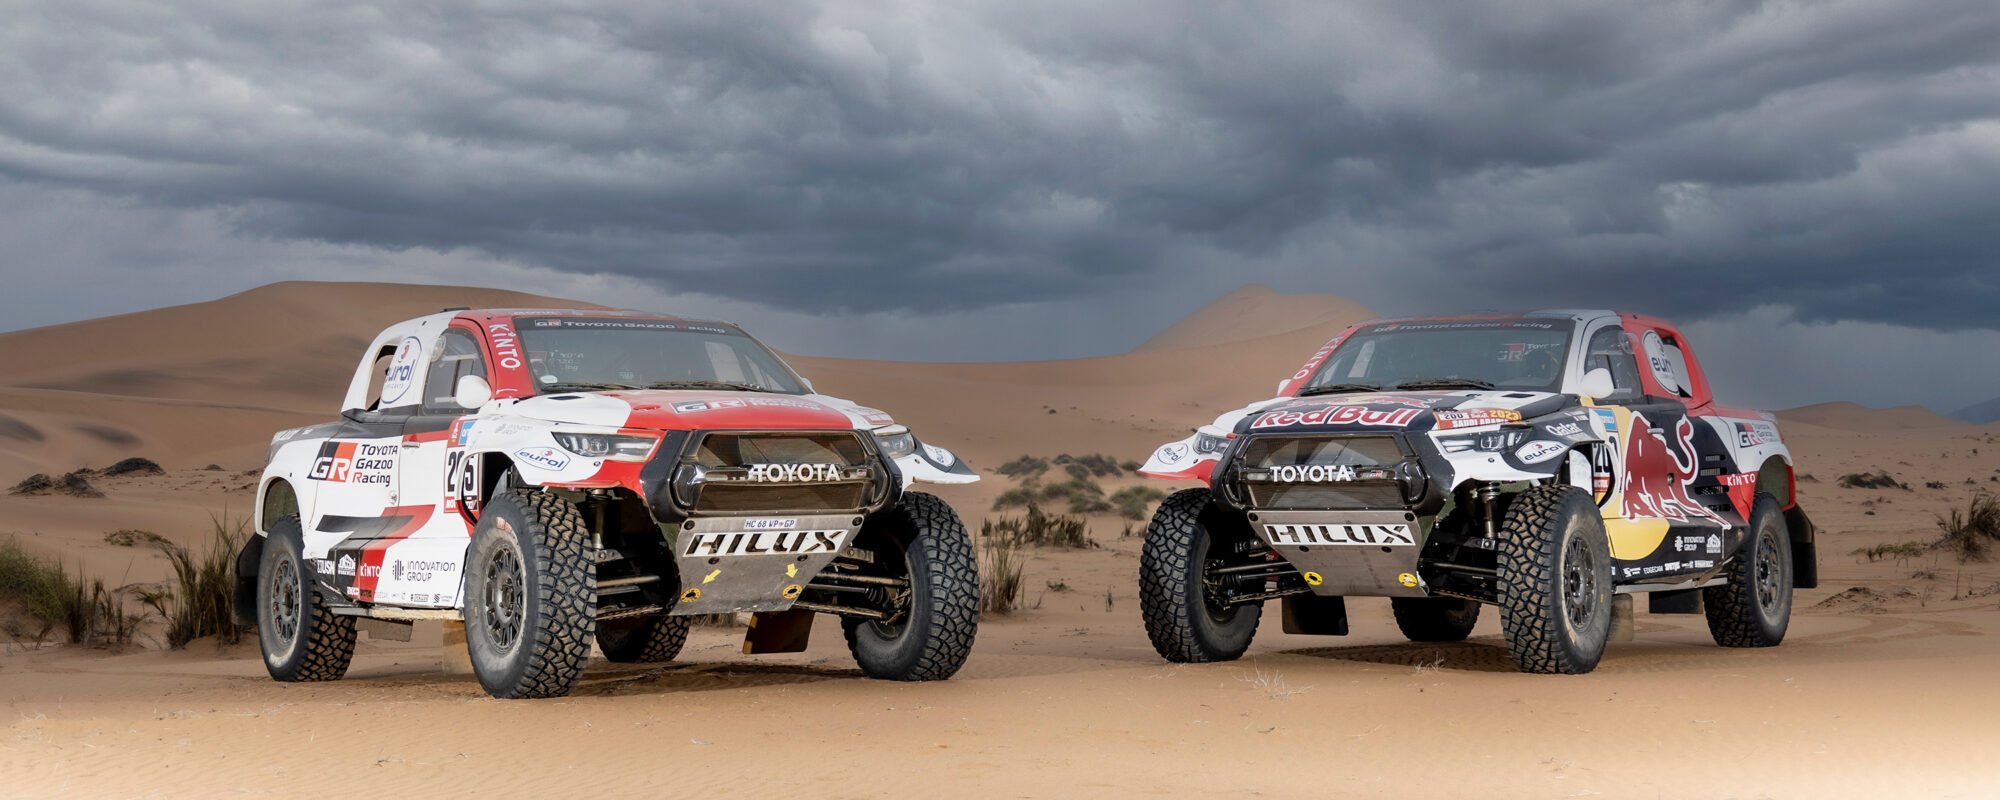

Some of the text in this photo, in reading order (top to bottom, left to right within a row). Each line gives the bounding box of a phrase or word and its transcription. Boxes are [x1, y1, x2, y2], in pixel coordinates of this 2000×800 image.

[677, 399, 742, 412] GR
[1489, 409, 1519, 421] 2023
[361, 444, 398, 456] TOYOTA
[1524, 444, 1563, 461] eurol
[356, 458, 393, 470] GAZOO
[520, 450, 565, 468] eurol
[311, 457, 351, 480] GR
[753, 464, 841, 482] TOYOTA
[1270, 465, 1352, 482] TOYOTA
[352, 472, 391, 487] Racing
[1266, 525, 1413, 544] HILUX
[684, 531, 844, 556] HILUX
[407, 561, 456, 571] INNOVATION
[407, 572, 432, 581] GROUP
